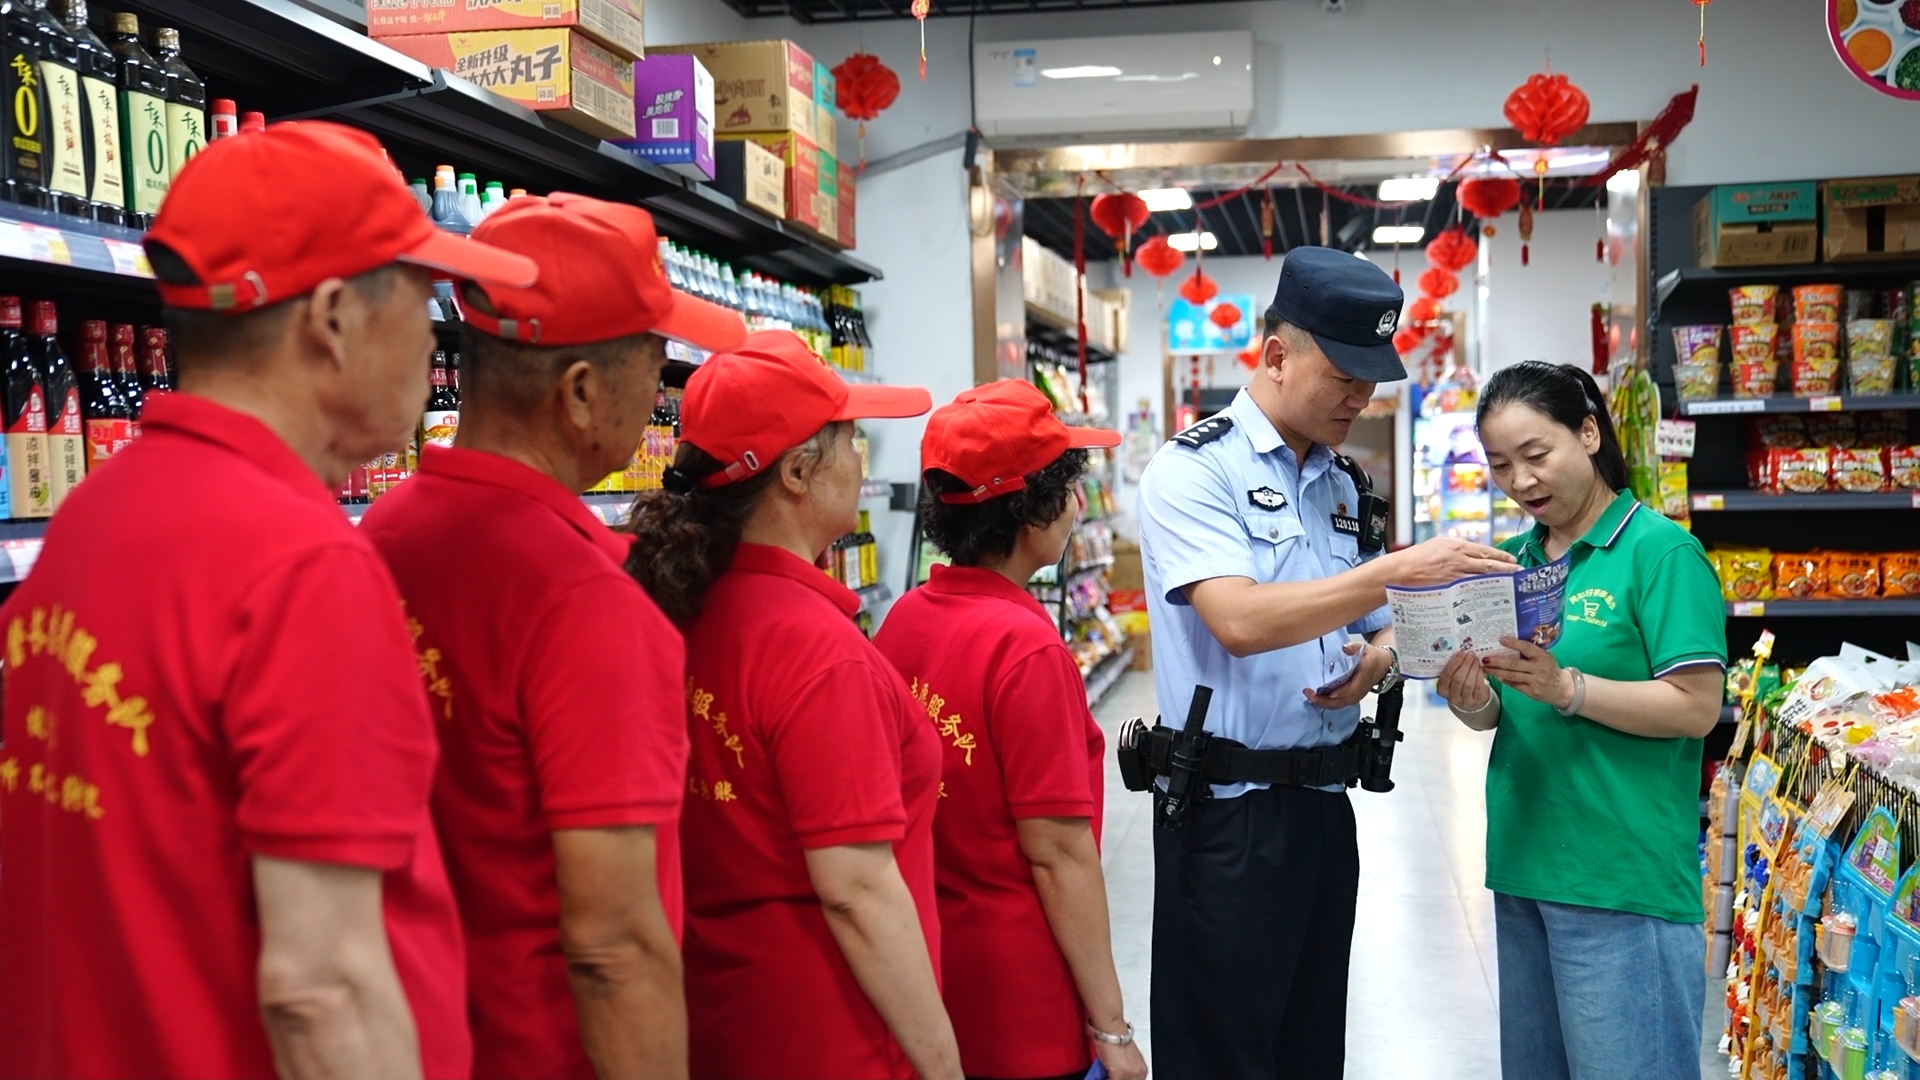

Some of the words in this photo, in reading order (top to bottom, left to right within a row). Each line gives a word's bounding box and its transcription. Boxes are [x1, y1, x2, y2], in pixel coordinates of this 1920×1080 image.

[10, 54, 38, 86] 千禾
[455, 43, 509, 73] 全新升级
[14, 86, 38, 137] 0
[143, 101, 164, 129] 千禾
[181, 111, 202, 138] 千禾
[147, 129, 164, 175] 0
